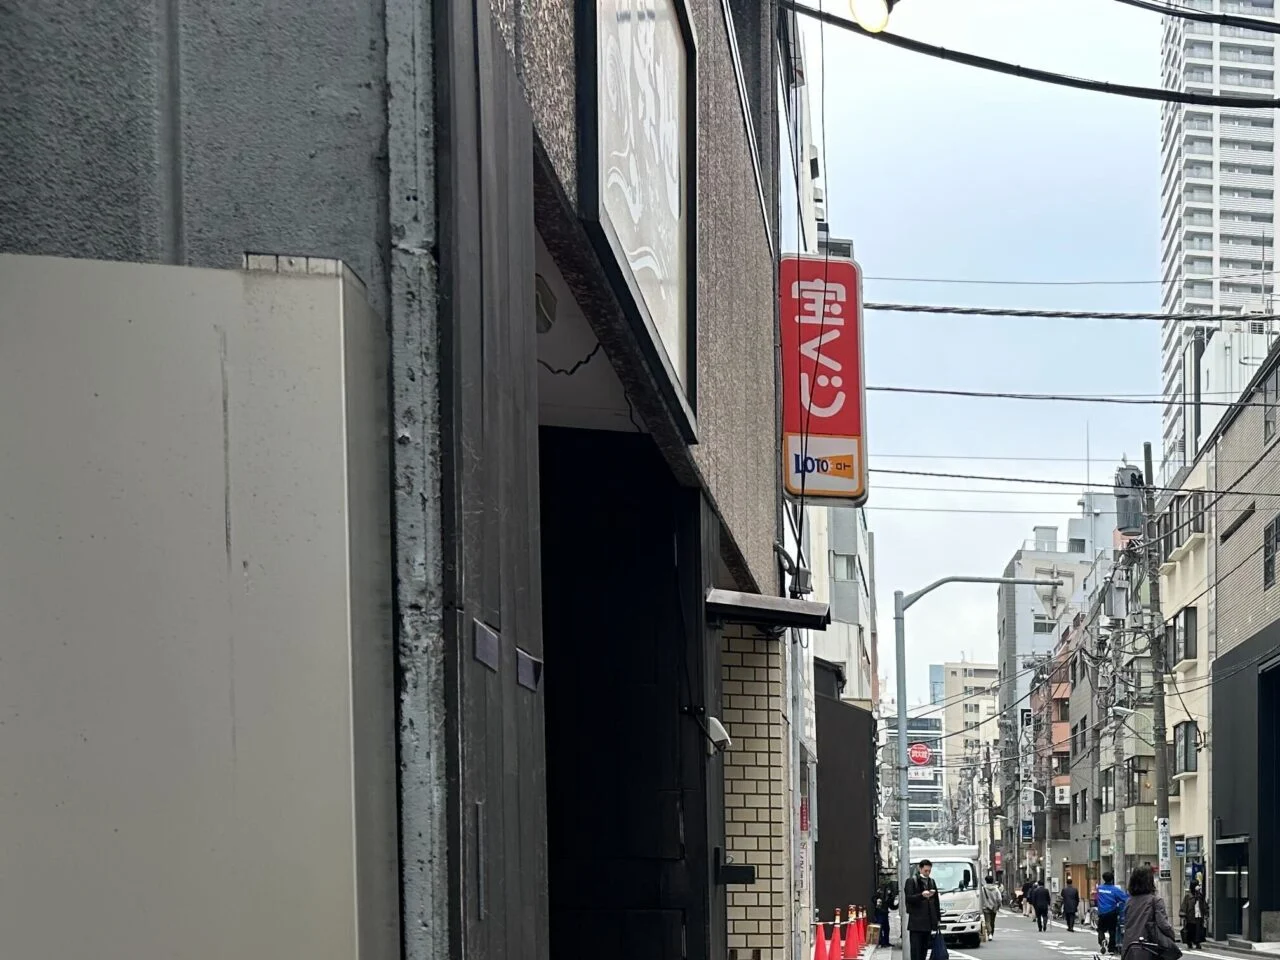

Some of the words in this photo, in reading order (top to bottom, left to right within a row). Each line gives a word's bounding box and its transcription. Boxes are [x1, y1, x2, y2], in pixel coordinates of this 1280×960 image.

[791, 277, 847, 418] 宝くじ
[794, 453, 829, 474] LOTO
